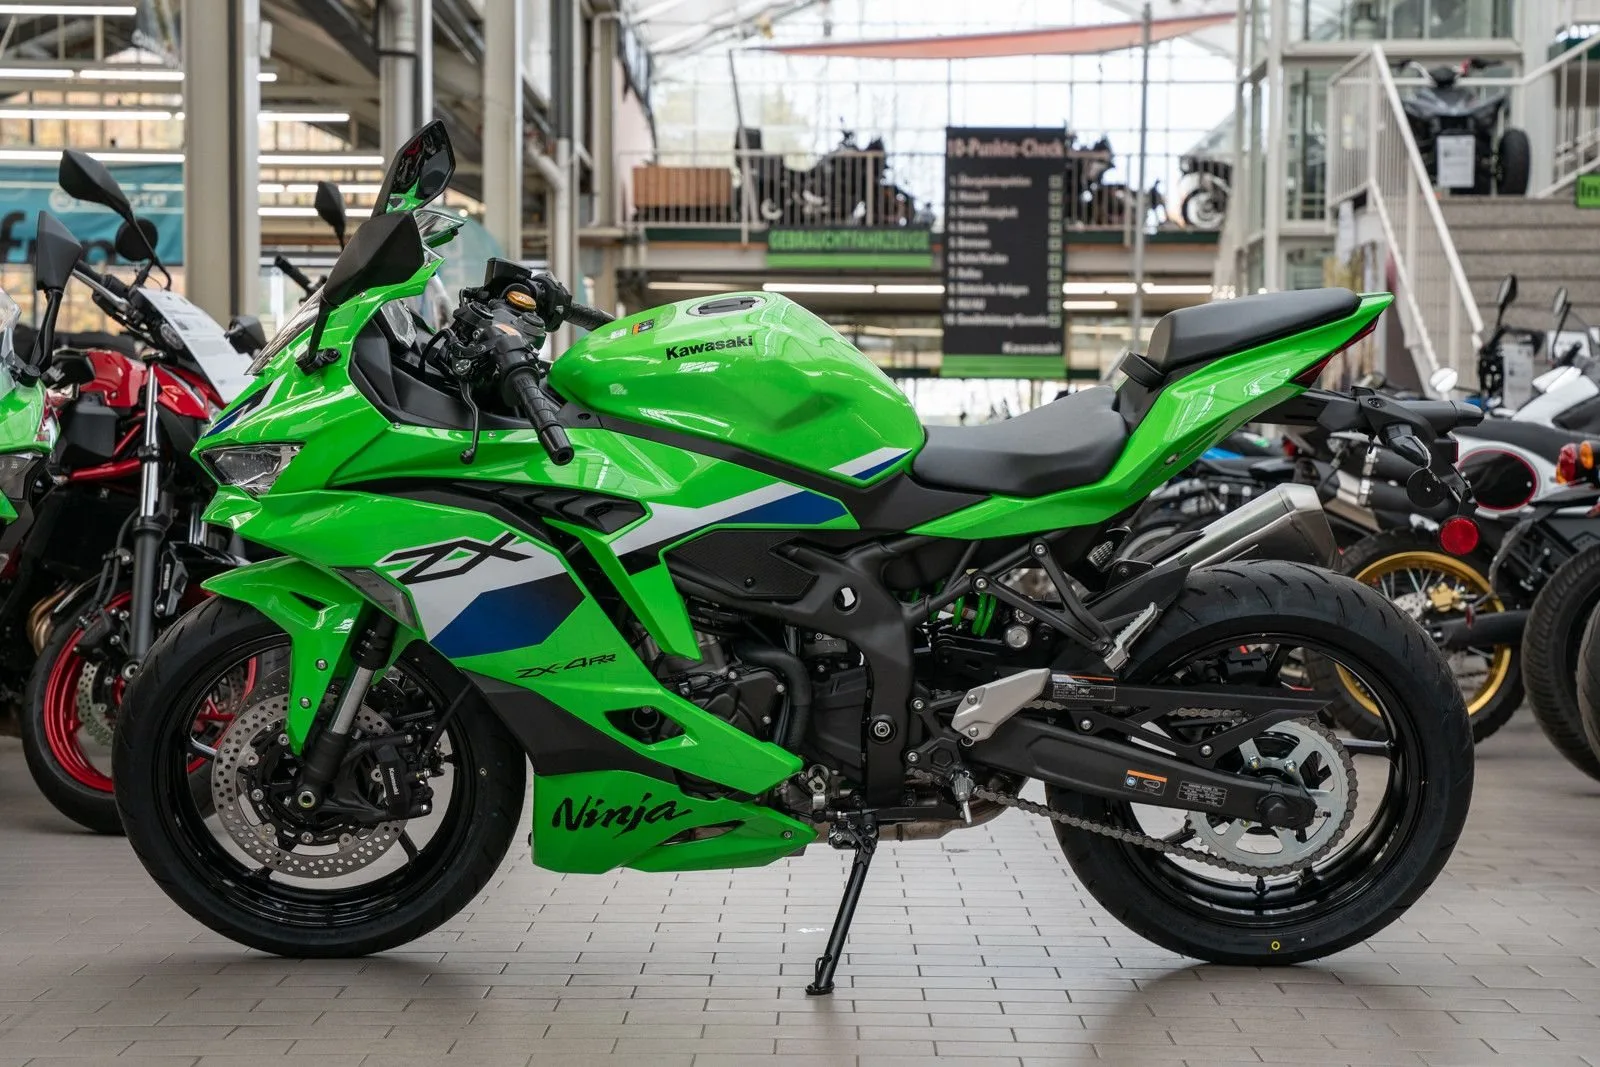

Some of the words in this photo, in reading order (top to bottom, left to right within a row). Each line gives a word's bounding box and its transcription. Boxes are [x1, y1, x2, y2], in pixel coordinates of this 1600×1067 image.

[665, 335, 753, 361] Kawasaki
[378, 531, 534, 586] ZX
[515, 653, 617, 679] ZX-4RR
[551, 792, 693, 839] Ninja
